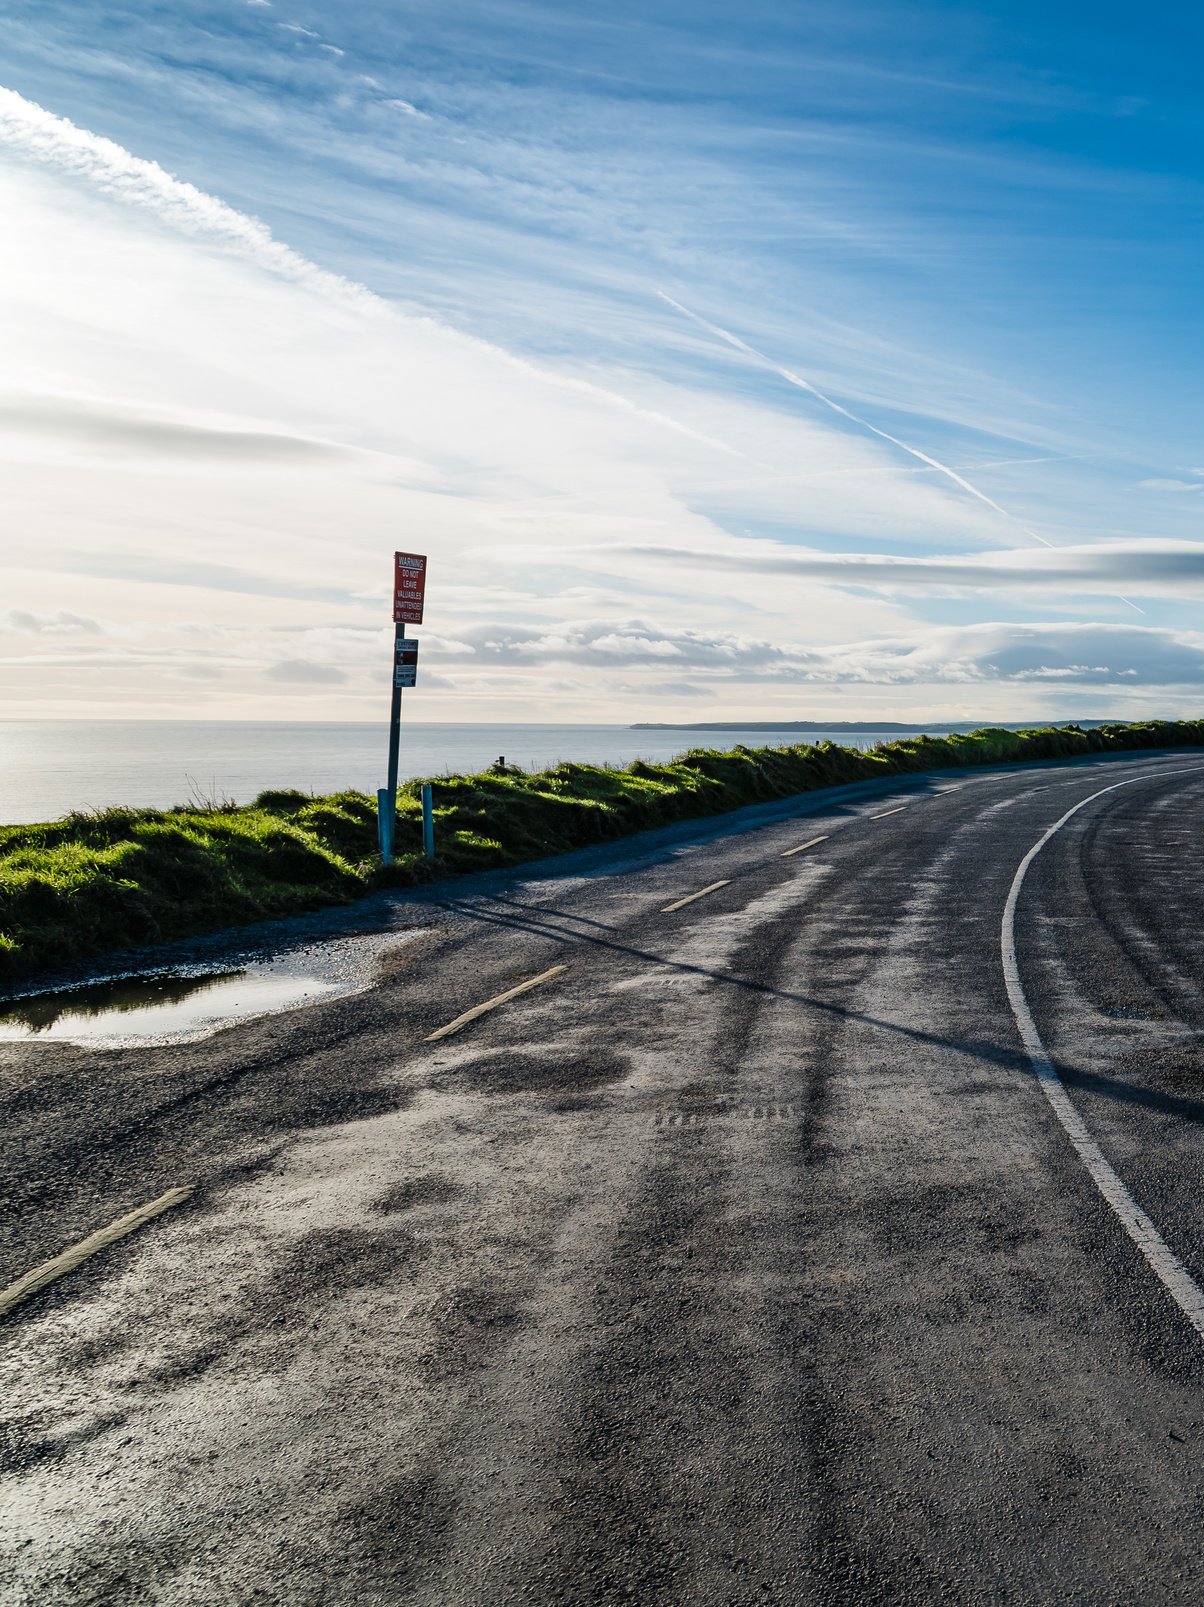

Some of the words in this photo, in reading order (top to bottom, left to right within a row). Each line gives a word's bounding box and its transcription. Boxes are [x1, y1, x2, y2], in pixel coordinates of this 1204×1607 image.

[399, 557, 423, 568] WARNING
[402, 569, 409, 577] DO
[410, 570, 419, 578] NOT
[403, 580, 417, 589] LEAVE
[397, 590, 422, 600] VALUABLES
[396, 600, 422, 610] UNATTENDED
[401, 612, 421, 620] VEHICLES
